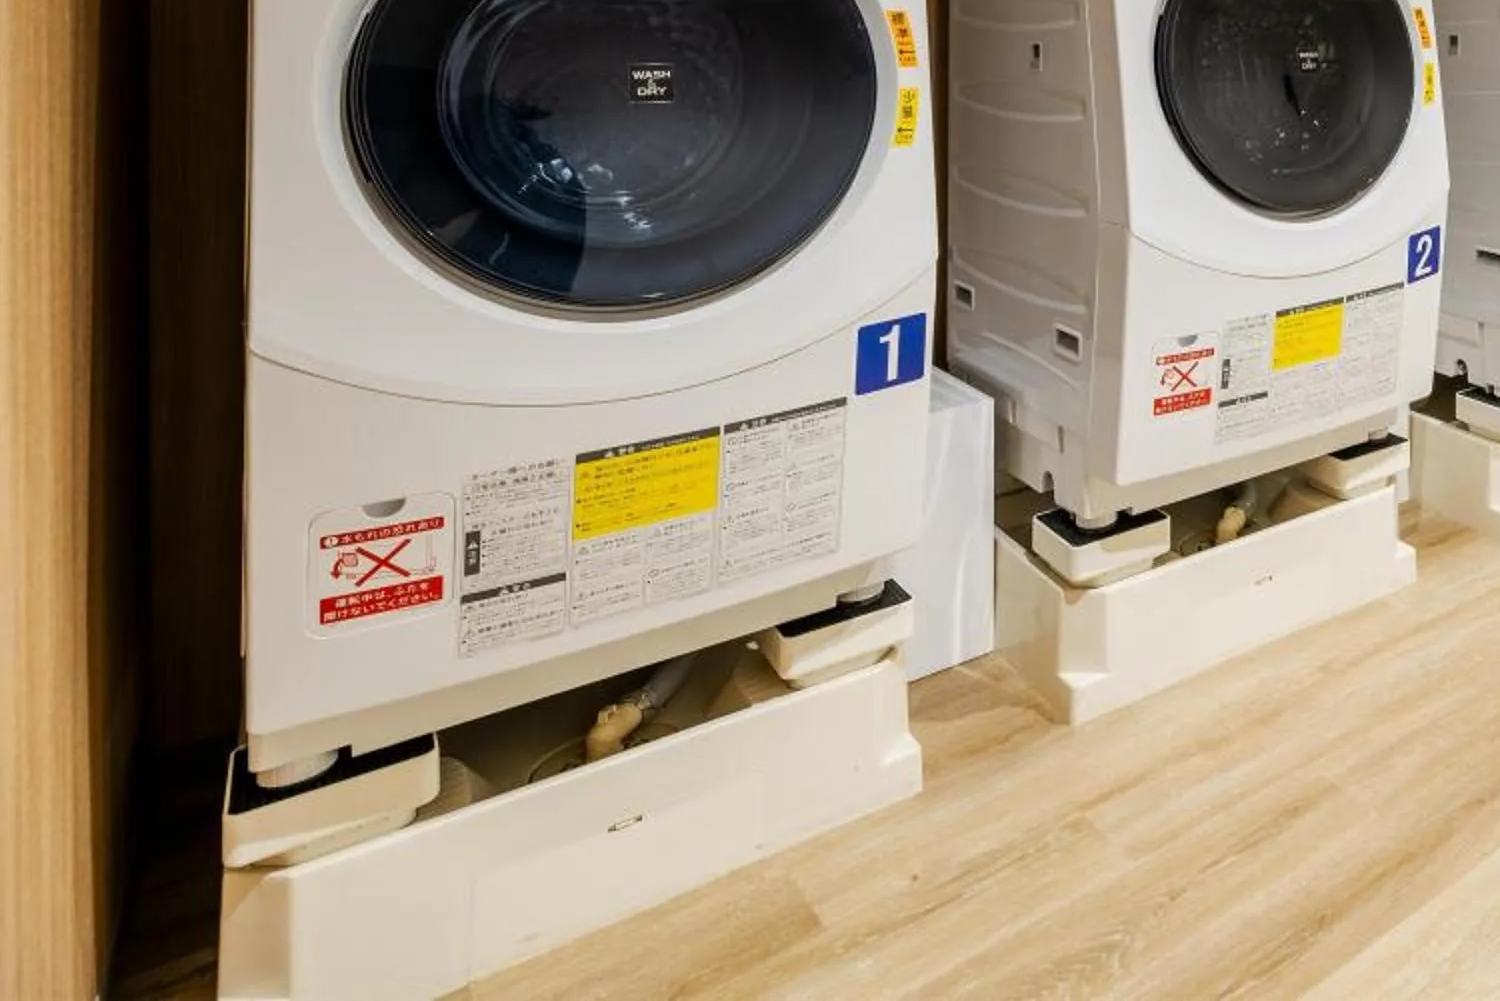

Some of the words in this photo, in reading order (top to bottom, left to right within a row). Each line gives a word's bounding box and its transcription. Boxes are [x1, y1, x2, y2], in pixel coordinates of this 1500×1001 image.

[637, 86, 667, 96] DRY
[1415, 234, 1433, 277] 2
[879, 324, 901, 382] 1
